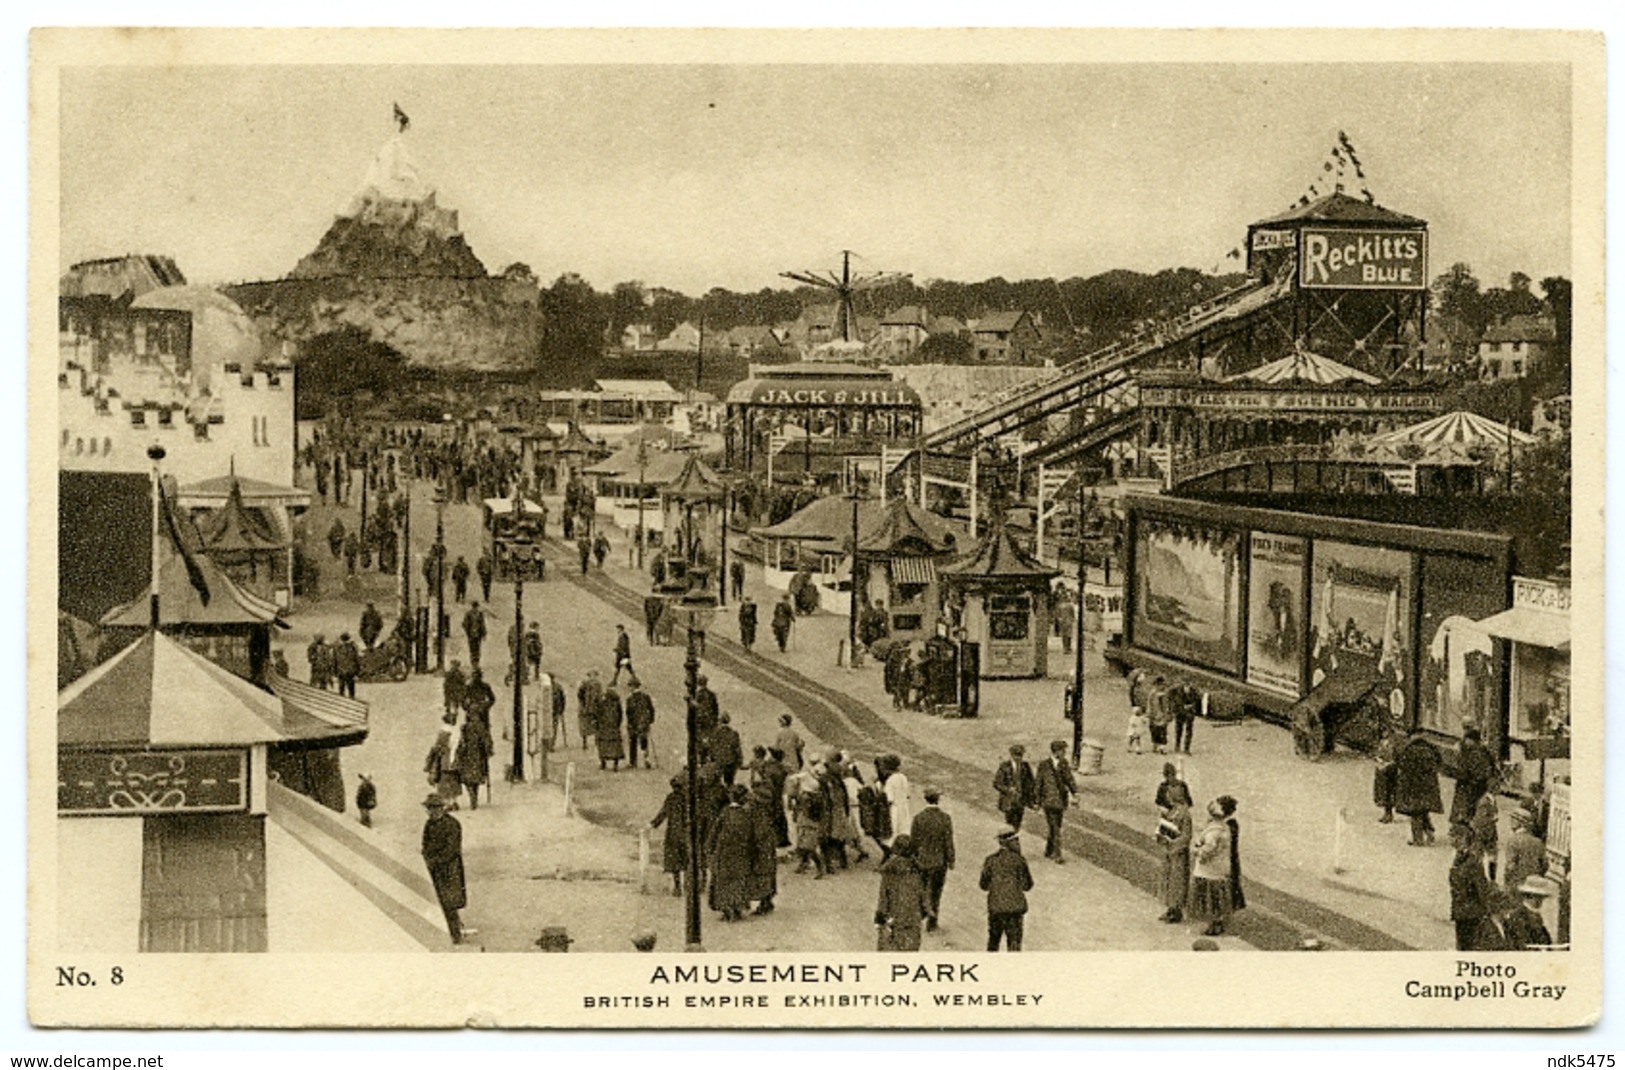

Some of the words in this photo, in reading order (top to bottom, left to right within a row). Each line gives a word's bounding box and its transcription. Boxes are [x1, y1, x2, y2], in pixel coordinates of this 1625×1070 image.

[1305, 235, 1418, 283] Reckitt's
[1362, 264, 1413, 282] BLUE
[760, 390, 827, 404] JACK
[834, 390, 848, 404] &
[854, 391, 912, 405] JILL
